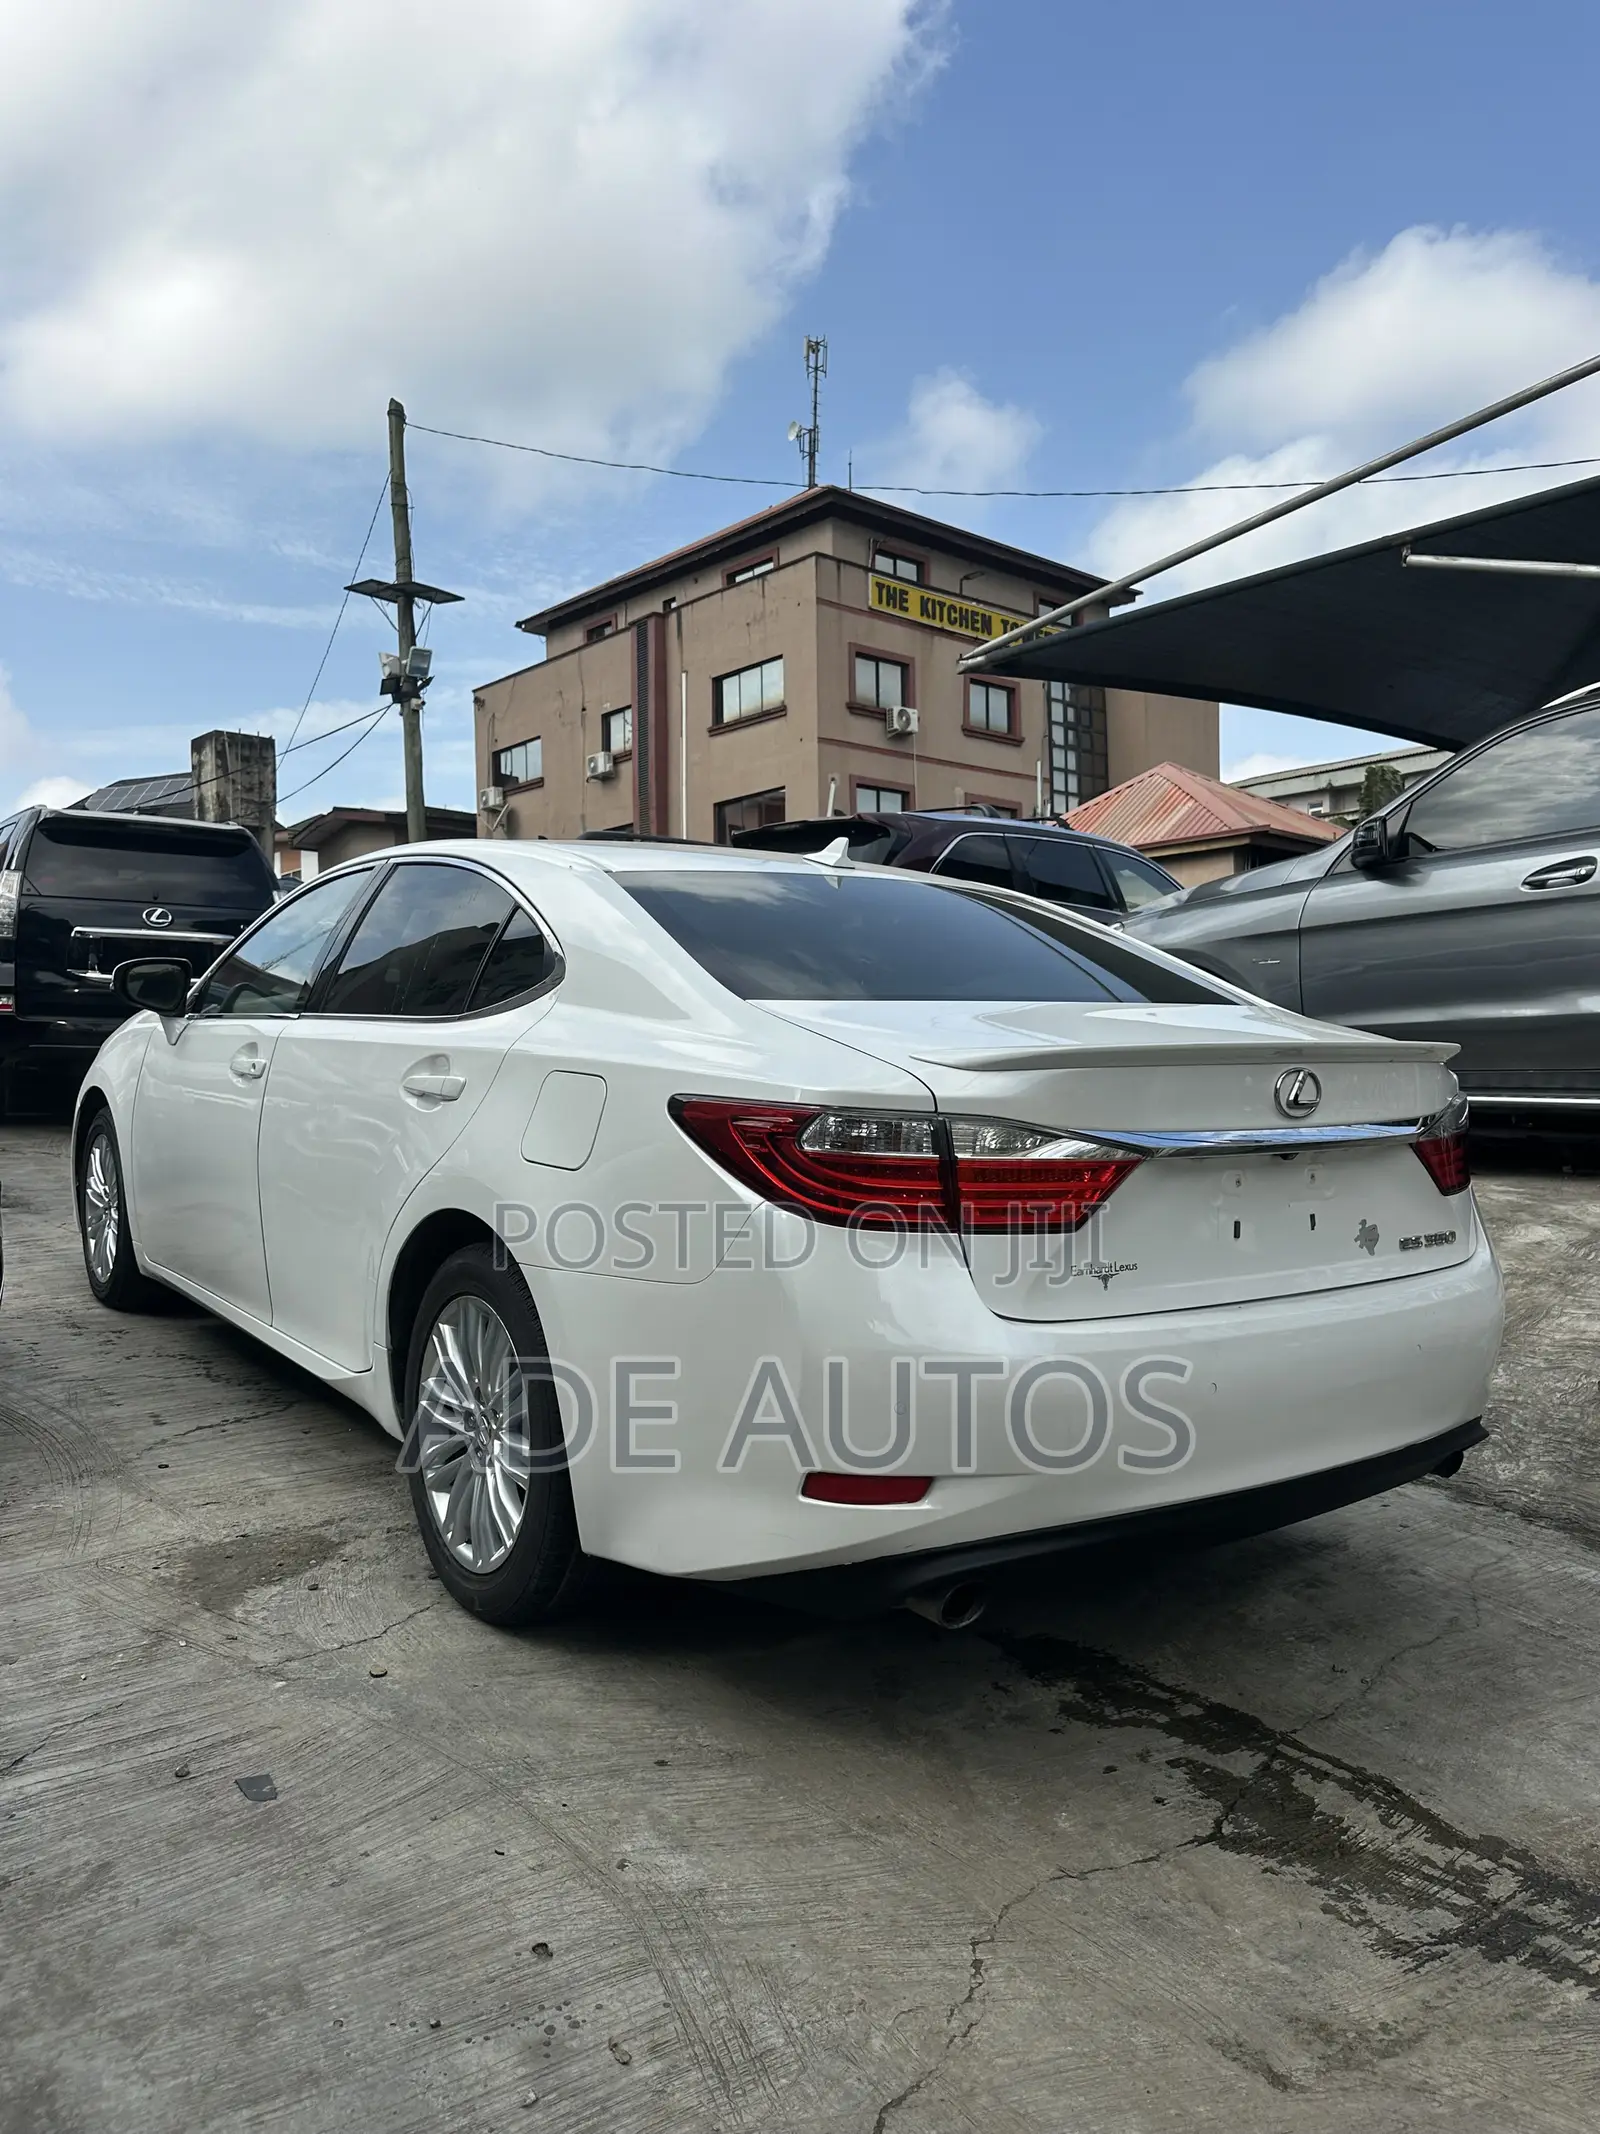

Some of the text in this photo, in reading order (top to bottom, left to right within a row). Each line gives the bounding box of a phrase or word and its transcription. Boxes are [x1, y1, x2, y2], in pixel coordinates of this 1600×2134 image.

[875, 581, 909, 613] THE
[919, 595, 993, 636] KITCHEN
[1399, 1235, 1423, 1251] ES
[1114, 1260, 1138, 1273] Lexus
